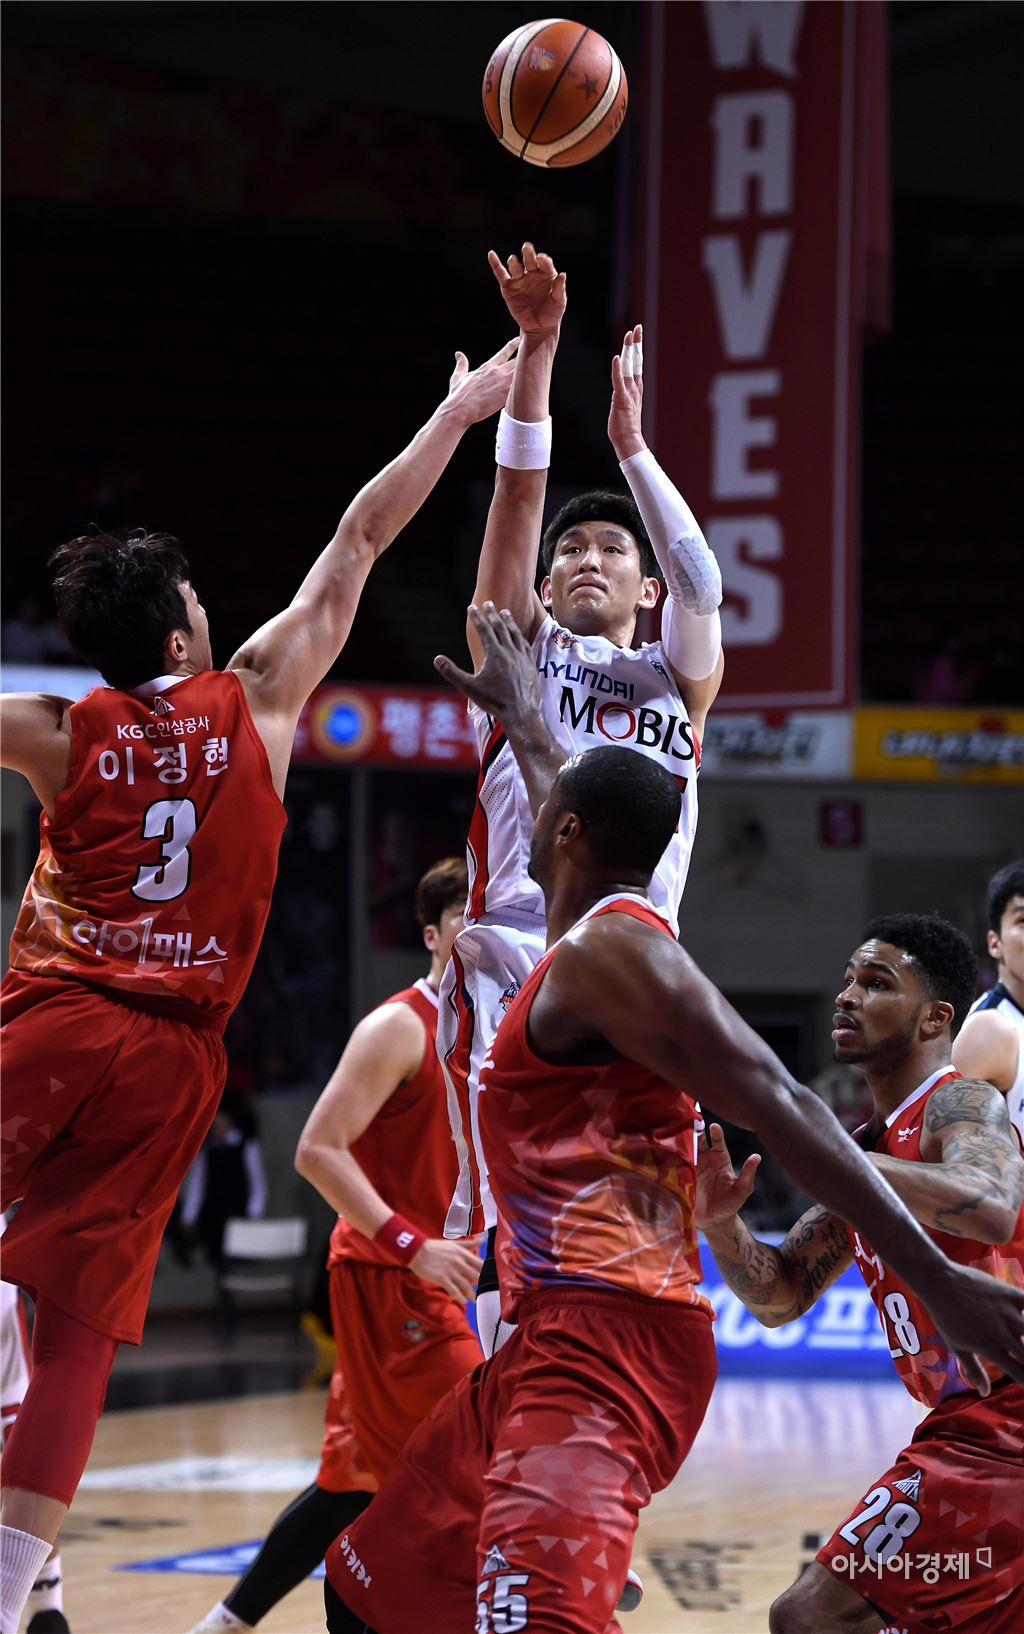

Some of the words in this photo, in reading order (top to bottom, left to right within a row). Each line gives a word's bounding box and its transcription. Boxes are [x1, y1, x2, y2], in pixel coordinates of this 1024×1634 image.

[701, 0, 806, 648] WAVES
[538, 661, 635, 701] HYUNDAI
[116, 716, 210, 740] KGC인삼공사
[559, 685, 695, 761] MOBIS
[131, 797, 198, 902] 3
[72, 917, 229, 968] 아이패스
[838, 1485, 922, 1566] 28
